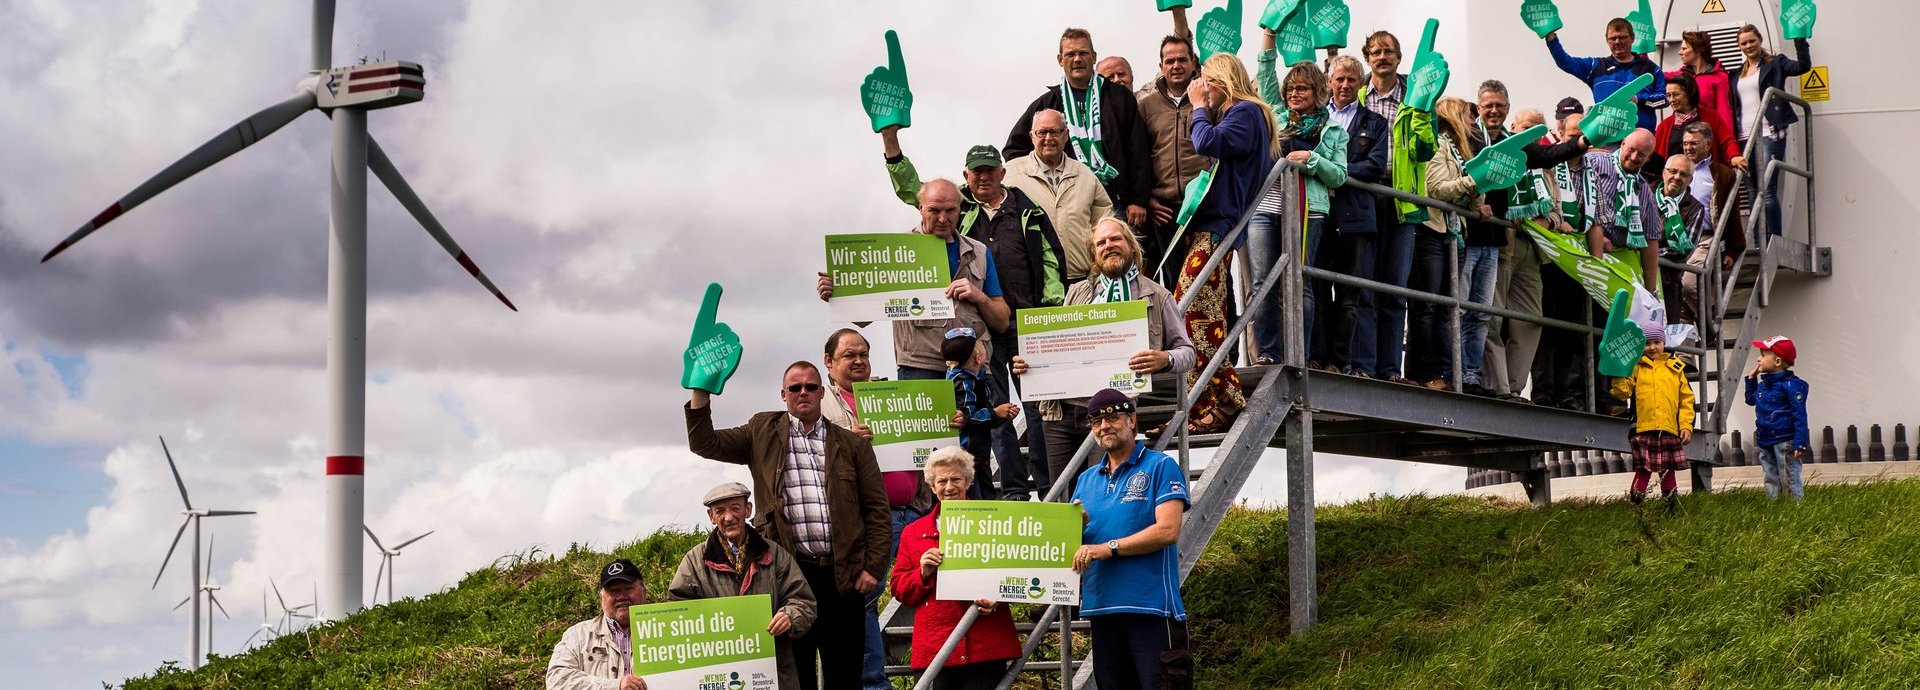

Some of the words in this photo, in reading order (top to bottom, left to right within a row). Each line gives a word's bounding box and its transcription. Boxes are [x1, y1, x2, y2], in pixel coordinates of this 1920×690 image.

[1206, 18, 1236, 39] ENERGIE
[1282, 42, 1302, 52] HAND
[870, 80, 906, 97] ENERGIE
[873, 91, 909, 109] BÜRGER-
[870, 104, 892, 115] HAND
[1597, 105, 1628, 119] ENERGIE
[1598, 125, 1618, 137] HAND
[1487, 149, 1519, 168] ENERGIE
[1485, 170, 1505, 184] HAND
[1489, 161, 1520, 179] BÜRGER-
[830, 246, 856, 265] Wir
[861, 246, 890, 264] sind
[895, 245, 916, 263] die
[832, 266, 938, 289] Energiewende!
[1024, 308, 1117, 325] Energiewende-Charta
[688, 333, 725, 360] ENERGIE
[1605, 330, 1634, 352] ENERGIE
[699, 344, 737, 366] BÜRGER-
[1620, 349, 1638, 366] HAND
[703, 359, 728, 375] HAND
[860, 394, 882, 414] Wir
[886, 394, 913, 412] sind
[916, 392, 933, 411] die
[945, 514, 974, 535] Wir
[978, 515, 1012, 536] sind
[1018, 516, 1042, 537] die
[944, 538, 1066, 563] Energiewende!
[999, 585, 1026, 594] ENERGIE
[1006, 576, 1028, 586] WENDE
[636, 617, 666, 639] Wir
[670, 614, 705, 636] sind
[710, 611, 735, 633] die
[638, 633, 761, 664] Energiewende!
[699, 682, 726, 690] ENERGIE
[704, 673, 727, 682] WENDE
